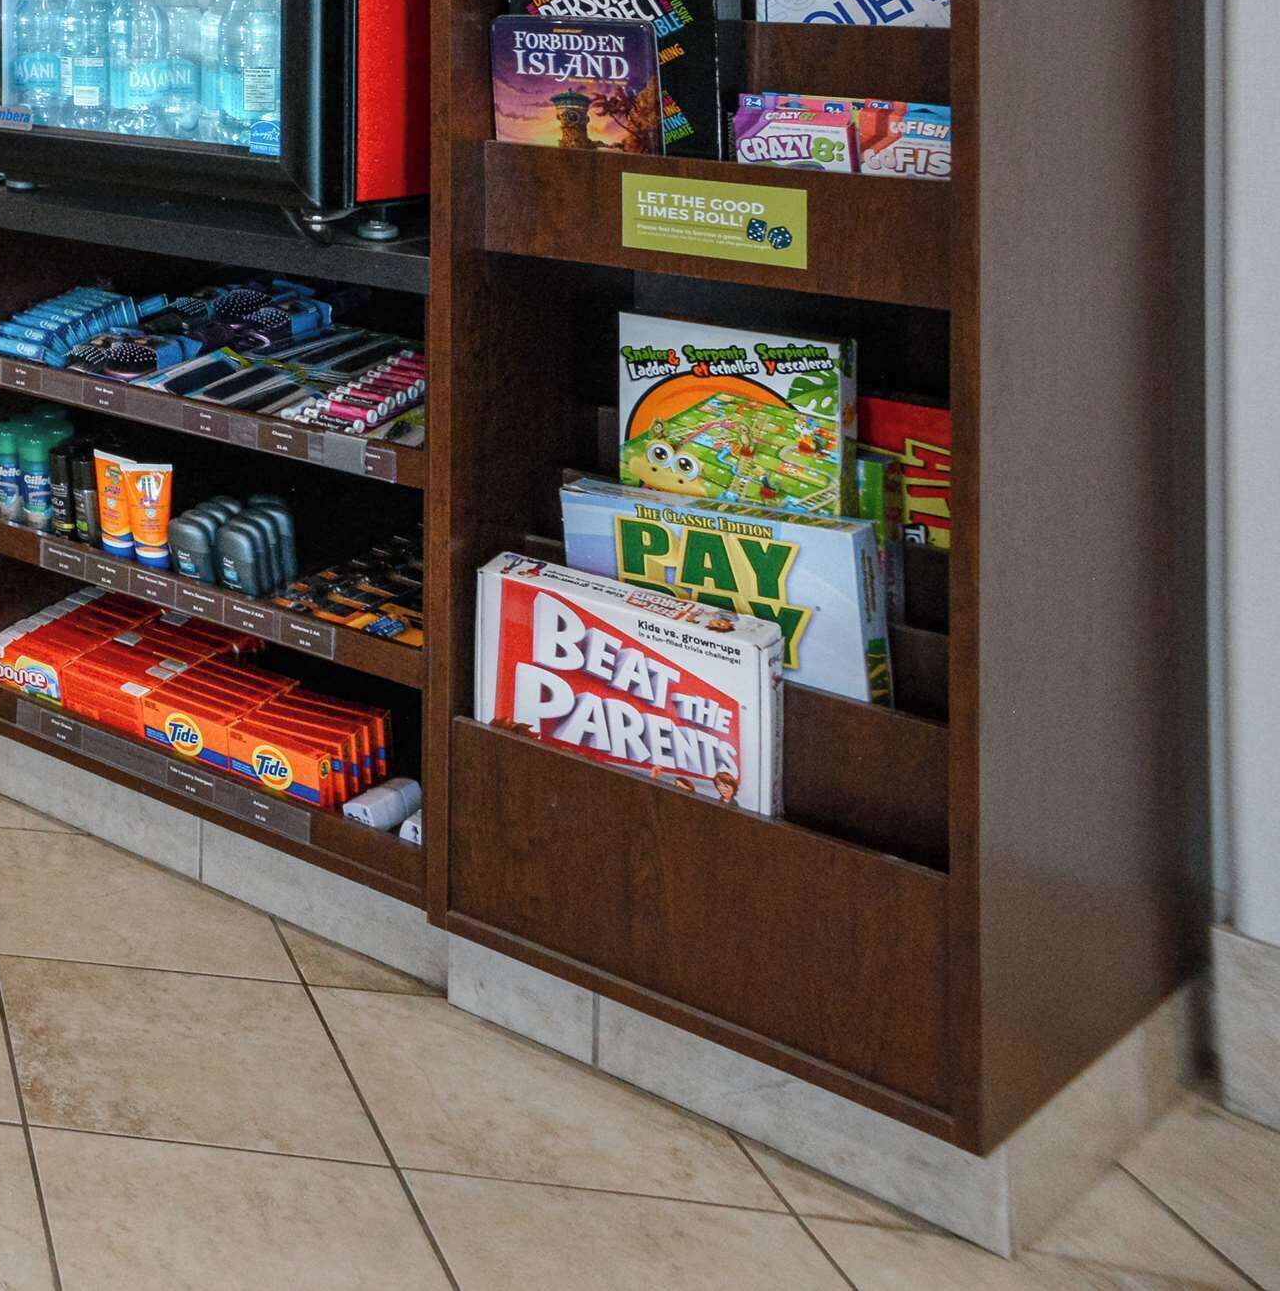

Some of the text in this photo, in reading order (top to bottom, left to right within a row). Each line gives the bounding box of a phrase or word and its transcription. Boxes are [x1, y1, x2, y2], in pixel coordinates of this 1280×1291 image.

[513, 30, 625, 53] FORBIDDEN
[513, 49, 630, 82] ISLAND
[765, 111, 801, 121] CRAZY
[905, 121, 950, 139] FISH
[740, 135, 812, 162] CRAZY
[637, 190, 765, 215] LET THE GOOD
[637, 204, 744, 227] TIMES ROLL!
[621, 345, 669, 364] Snakes
[682, 343, 747, 364] Serpents
[754, 342, 829, 363] Serpientes
[692, 360, 708, 378] et
[777, 358, 834, 374] escaleras
[635, 503, 772, 539] THE CLASSIC EDITION
[618, 517, 795, 602] PAY
[638, 619, 741, 657] Kids vs. grown-ups
[532, 590, 680, 708] BEAT
[671, 693, 733, 734] THE
[514, 661, 739, 775] PARENTS
[168, 722, 199, 745] Tide
[255, 754, 288, 778] Tide
